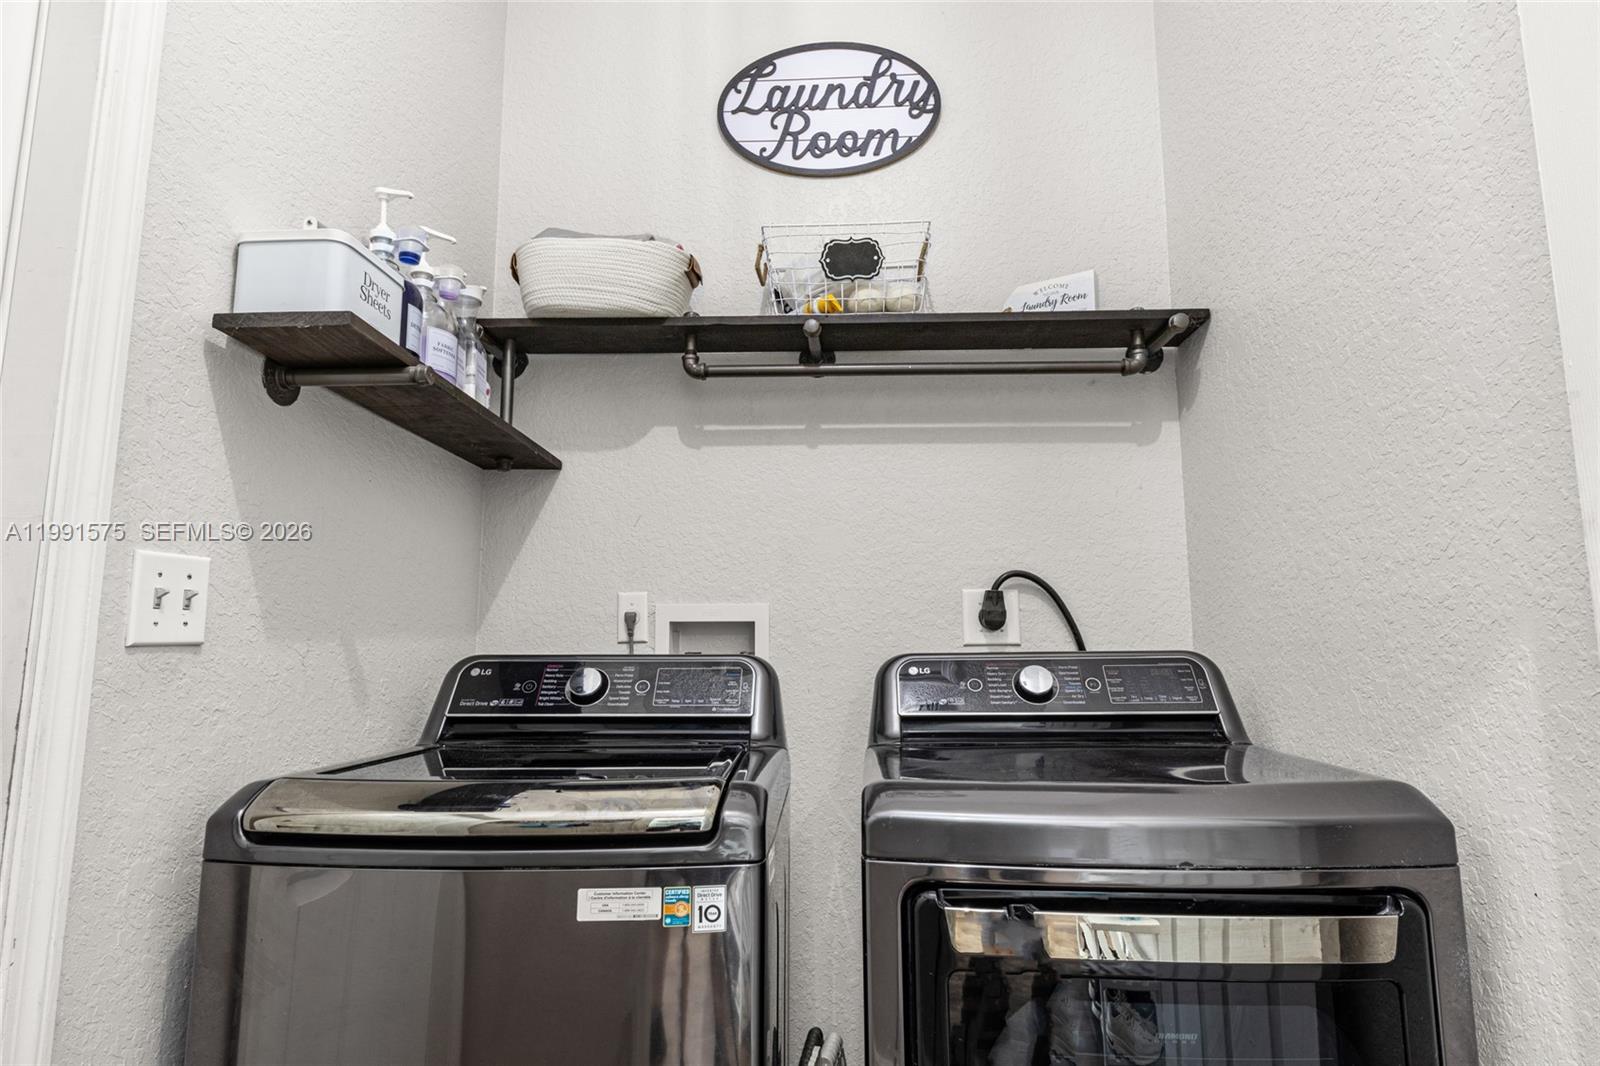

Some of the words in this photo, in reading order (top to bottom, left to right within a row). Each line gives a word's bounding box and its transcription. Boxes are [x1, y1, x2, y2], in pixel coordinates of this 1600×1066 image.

[731, 54, 934, 119] Laundry
[760, 110, 913, 160] Room
[363, 271, 391, 303] Dryer
[1033, 283, 1069, 296] WELCOME
[1060, 292, 1088, 305] Room
[359, 284, 392, 321] Sheets
[1021, 295, 1058, 312] Laundry
[698, 904, 721, 923] 10
